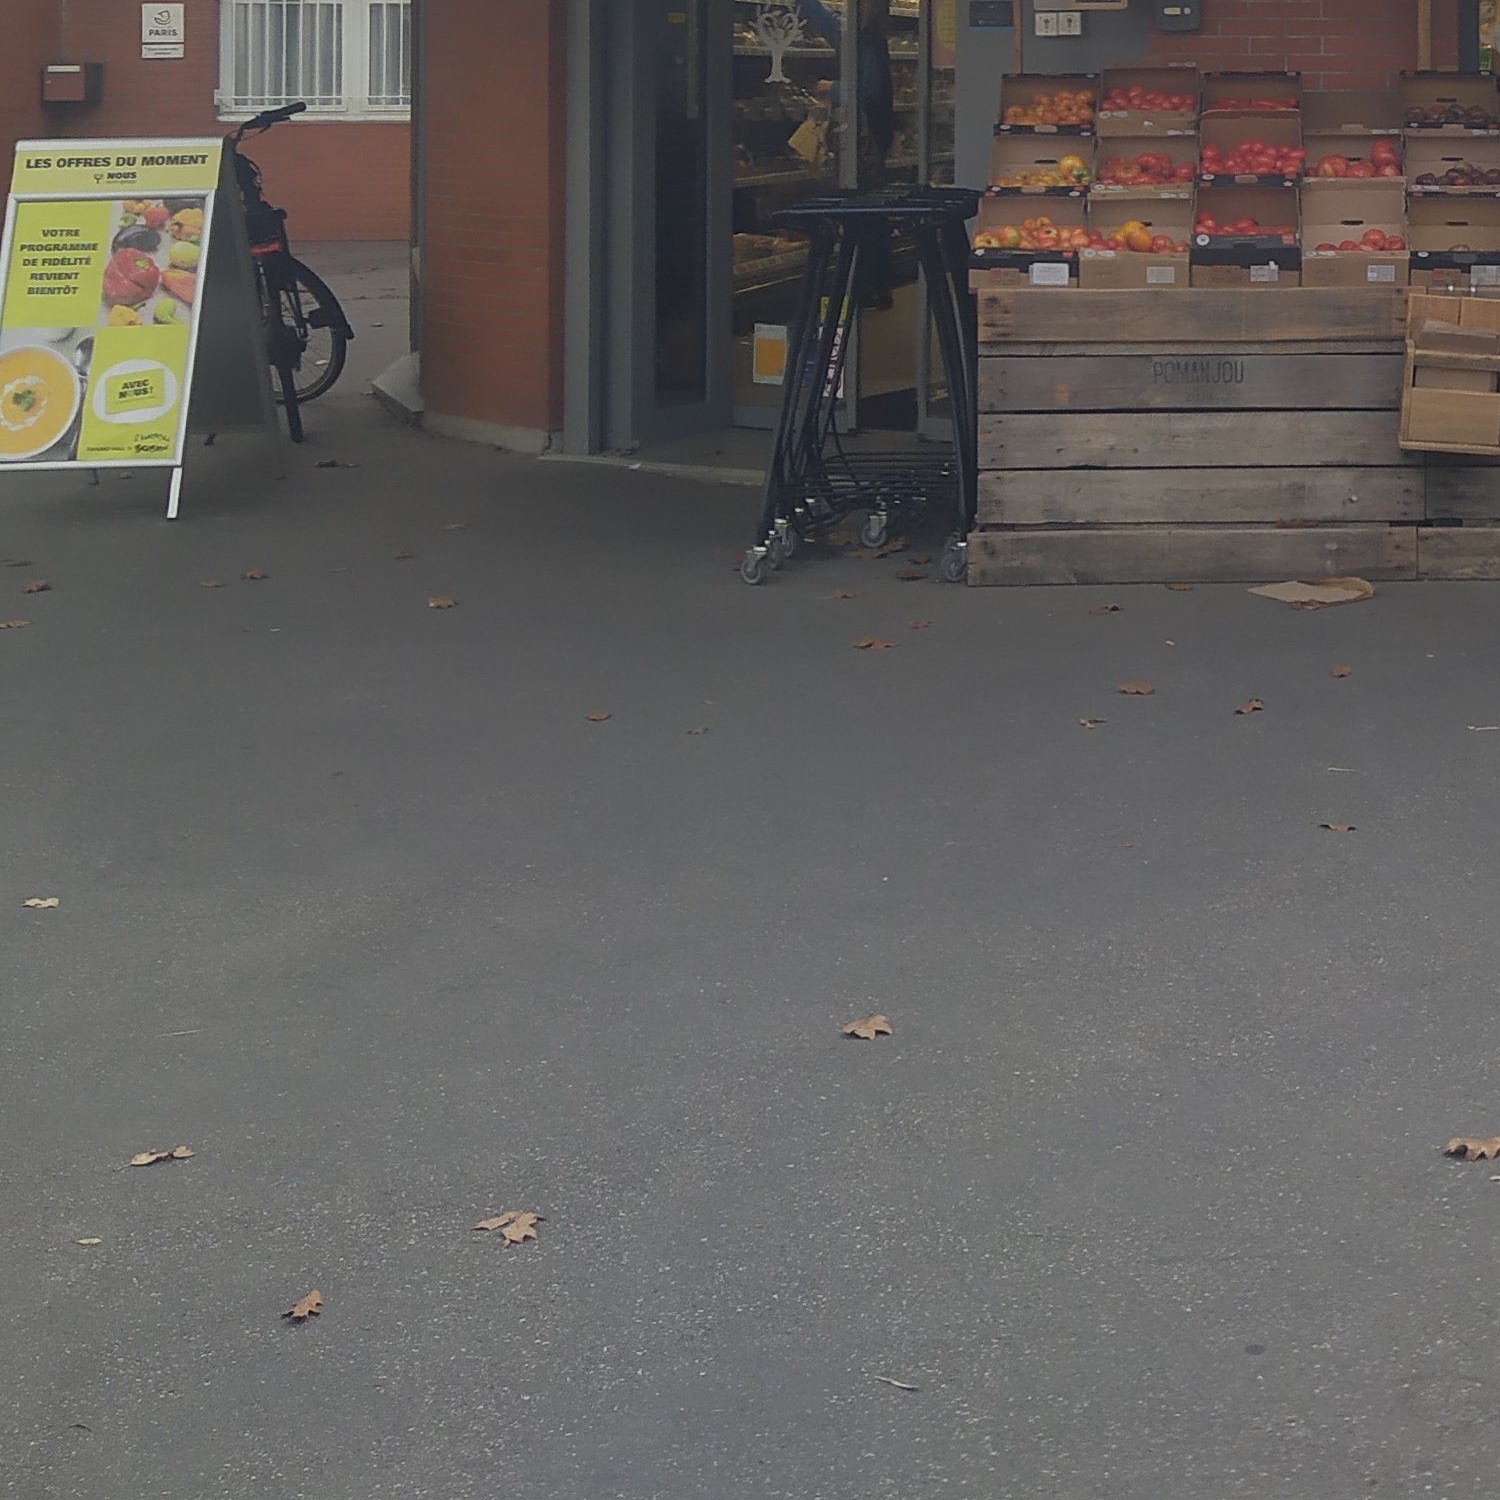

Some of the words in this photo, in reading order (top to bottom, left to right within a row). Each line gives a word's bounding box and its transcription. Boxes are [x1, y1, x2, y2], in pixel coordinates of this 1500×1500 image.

[25, 158, 52, 169] LES
[56, 157, 111, 168] OFFRES
[115, 156, 137, 167] DU
[141, 155, 208, 166] MOMENT
[106, 171, 137, 180] NOUS
[42, 229, 80, 237] VOTRE
[19, 243, 98, 252] PROGRAMME
[22, 258, 38, 266] DE
[42, 256, 91, 266] FIDÉLITÉ
[29, 272, 80, 280] REVIENT
[27, 285, 78, 294] BIENTÔT
[121, 378, 149, 389] AVEC
